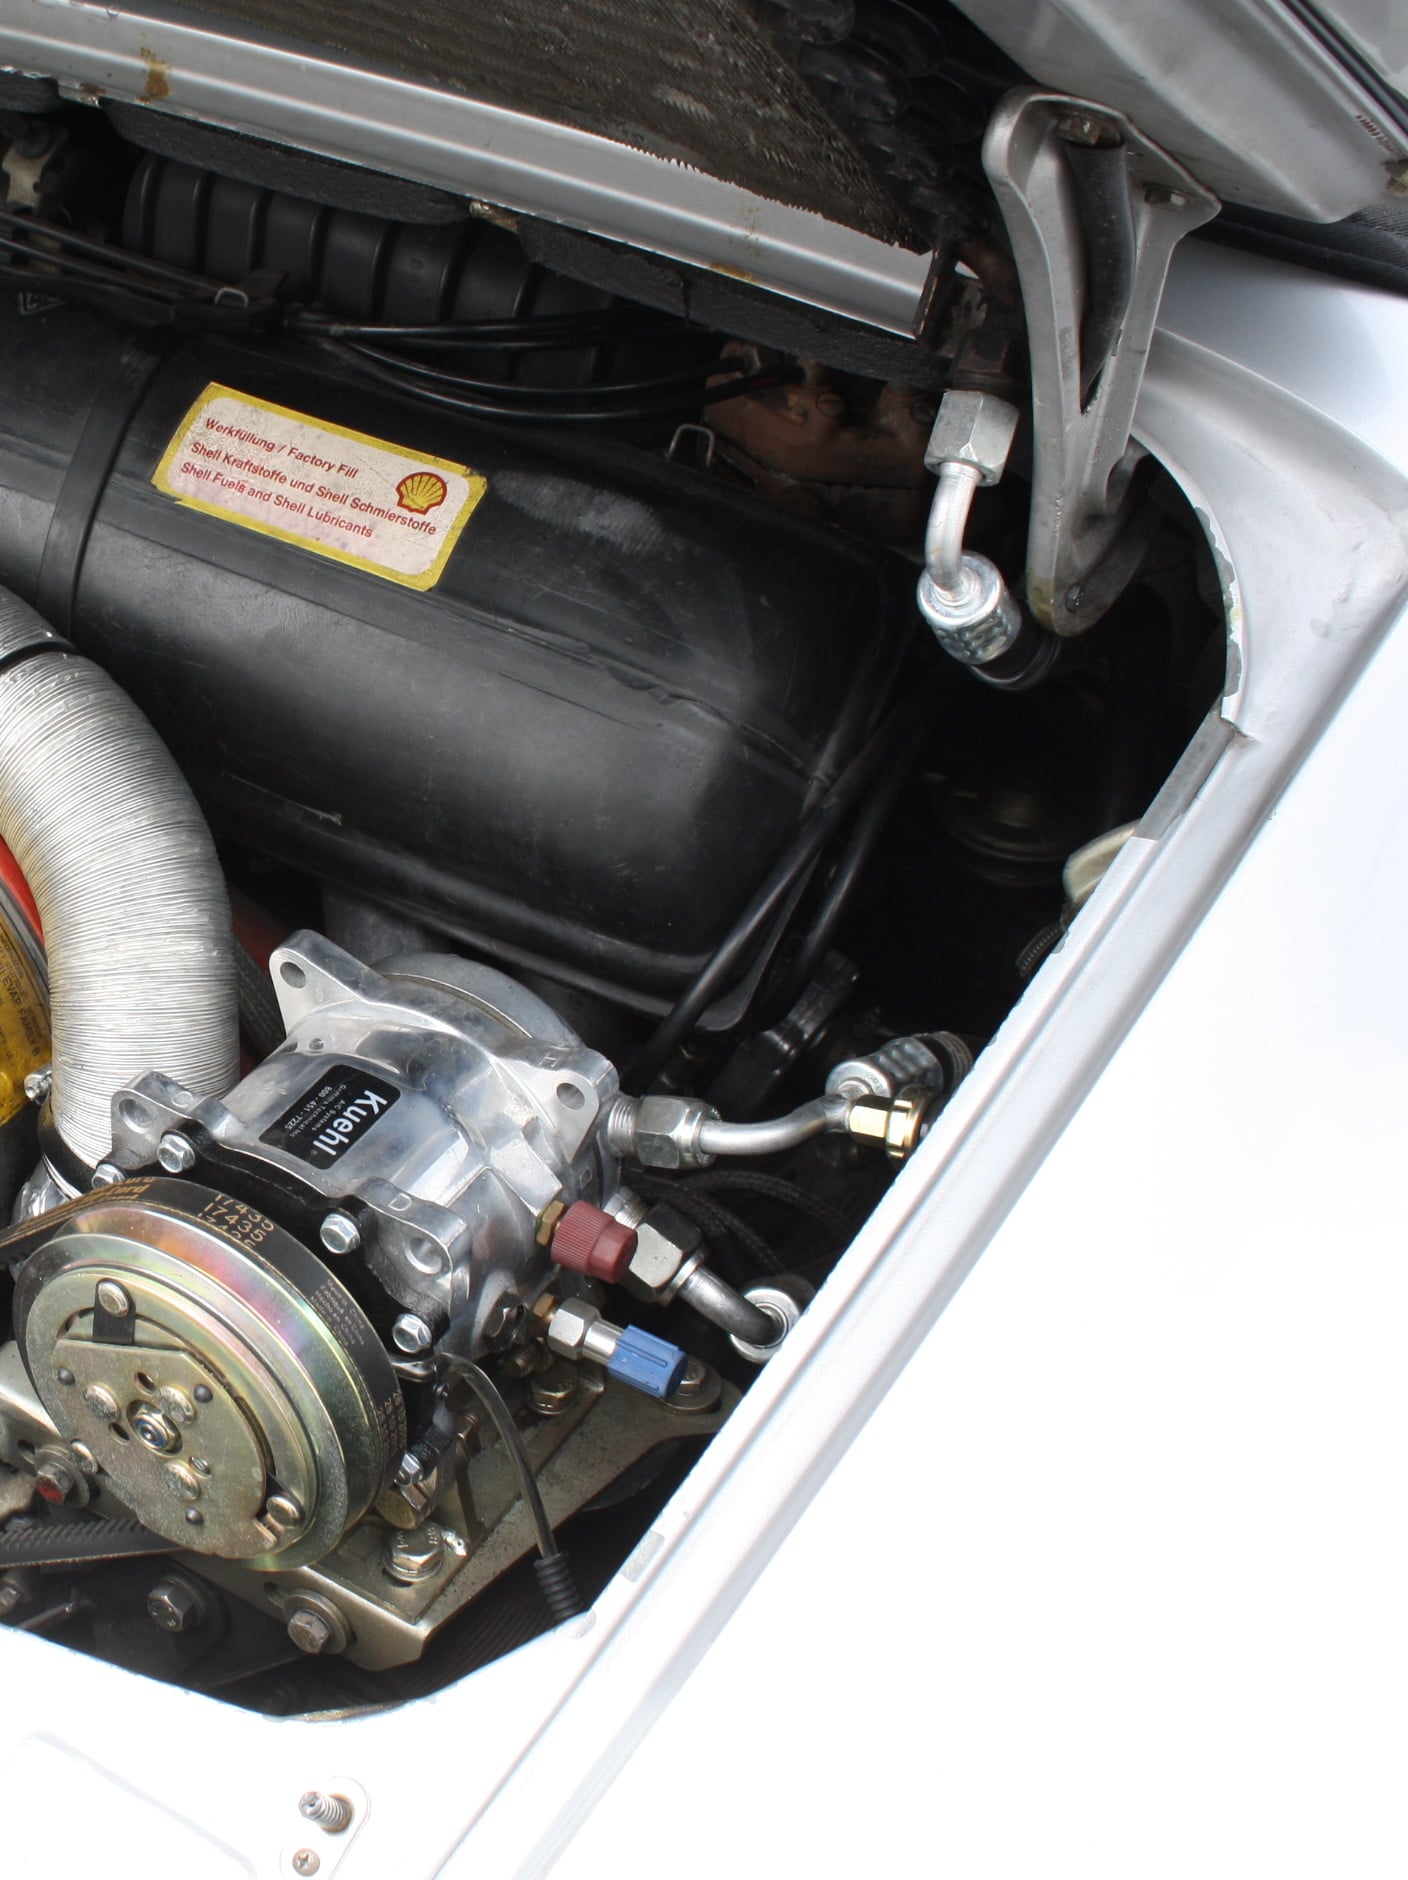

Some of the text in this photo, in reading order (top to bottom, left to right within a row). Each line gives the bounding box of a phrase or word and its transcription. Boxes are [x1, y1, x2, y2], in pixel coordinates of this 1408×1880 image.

[205, 417, 276, 453] Werkfüllung
[288, 447, 334, 473] Factory
[338, 463, 359, 479] Fill
[180, 462, 211, 481] Shell
[247, 483, 272, 503] and
[273, 491, 305, 514] Shell
[307, 503, 373, 538] Lubricants
[191, 442, 437, 535] Shell Kraftstoffe und Shell Schmierstoffe
[311, 1089, 388, 1156] Kuehl
[203, 1202, 266, 1241] 17435
